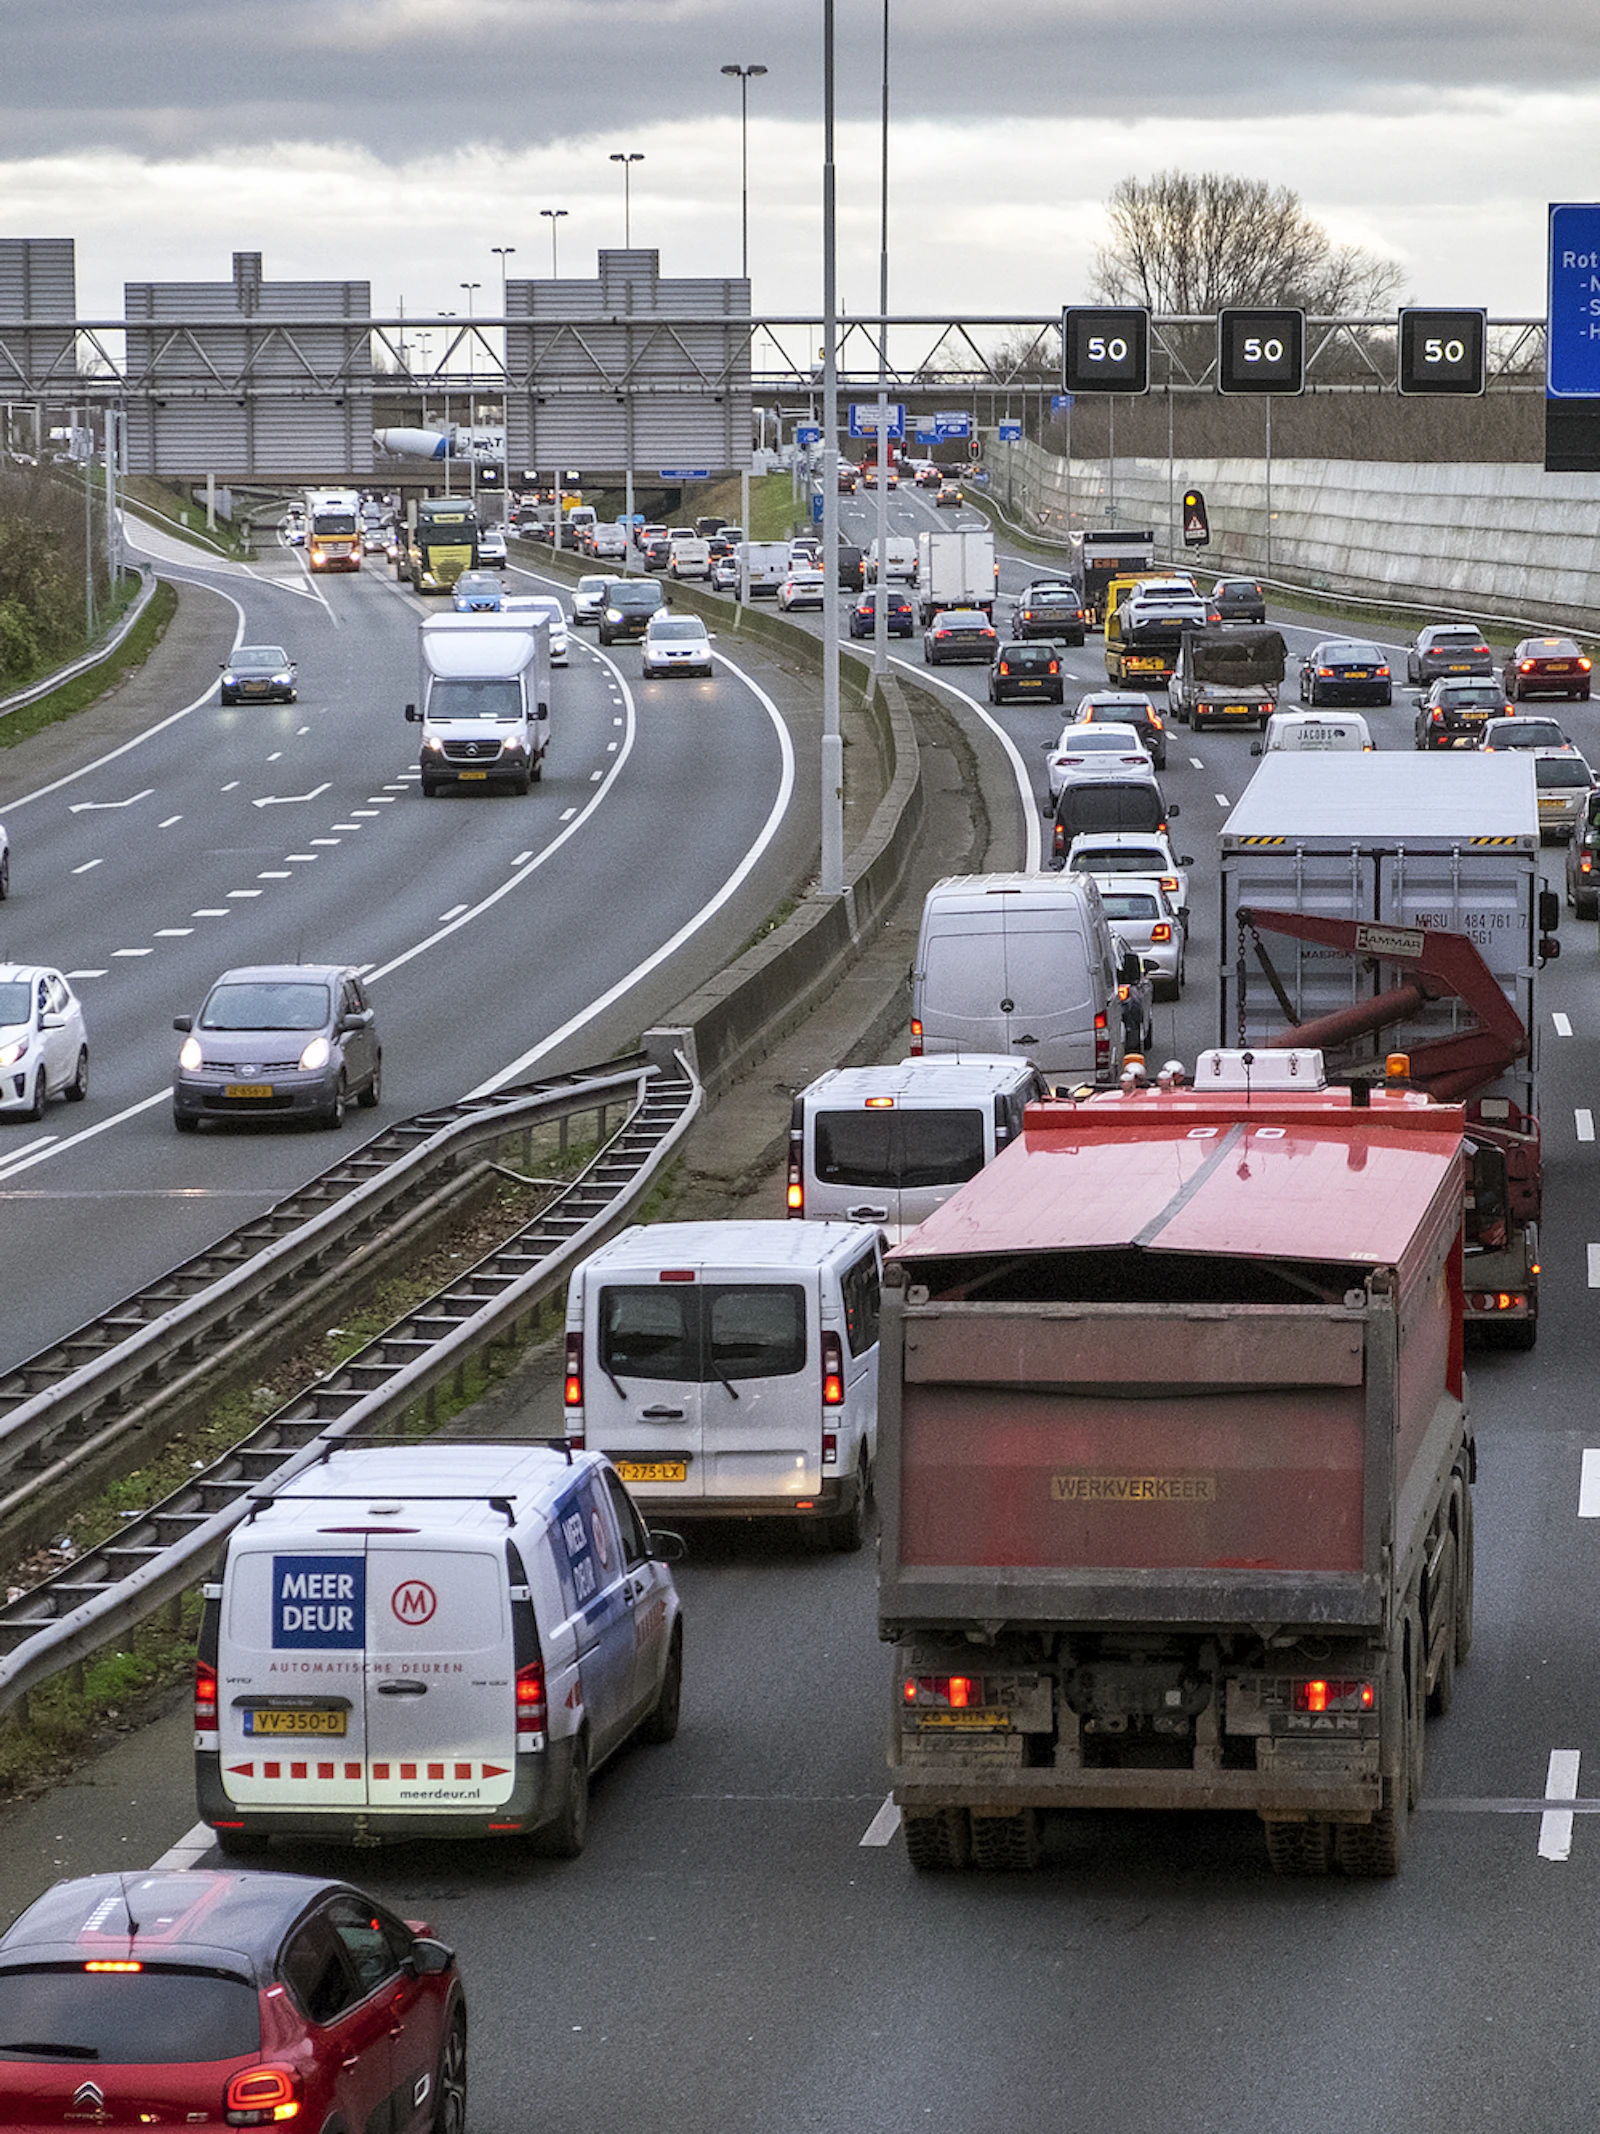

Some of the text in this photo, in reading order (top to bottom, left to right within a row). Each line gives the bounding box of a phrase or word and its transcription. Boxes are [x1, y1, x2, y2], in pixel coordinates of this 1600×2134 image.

[1087, 337, 1128, 362] 50
[1243, 338, 1284, 363] 50
[1424, 339, 1465, 364] 50
[1297, 729, 1332, 740] JACOBS
[1464, 914, 1485, 928] 484
[1490, 914, 1510, 928] 761
[1057, 1478, 1209, 1498] WERKVERKEER
[281, 1573, 354, 1600] MEER
[401, 1590, 427, 1615] M
[282, 1606, 354, 1632] DEUR
[269, 1662, 463, 1674] AUTOMATISCHE DEUREN
[258, 1714, 338, 1730] VV-350-D
[400, 1788, 480, 1799] meerdeur.nl
